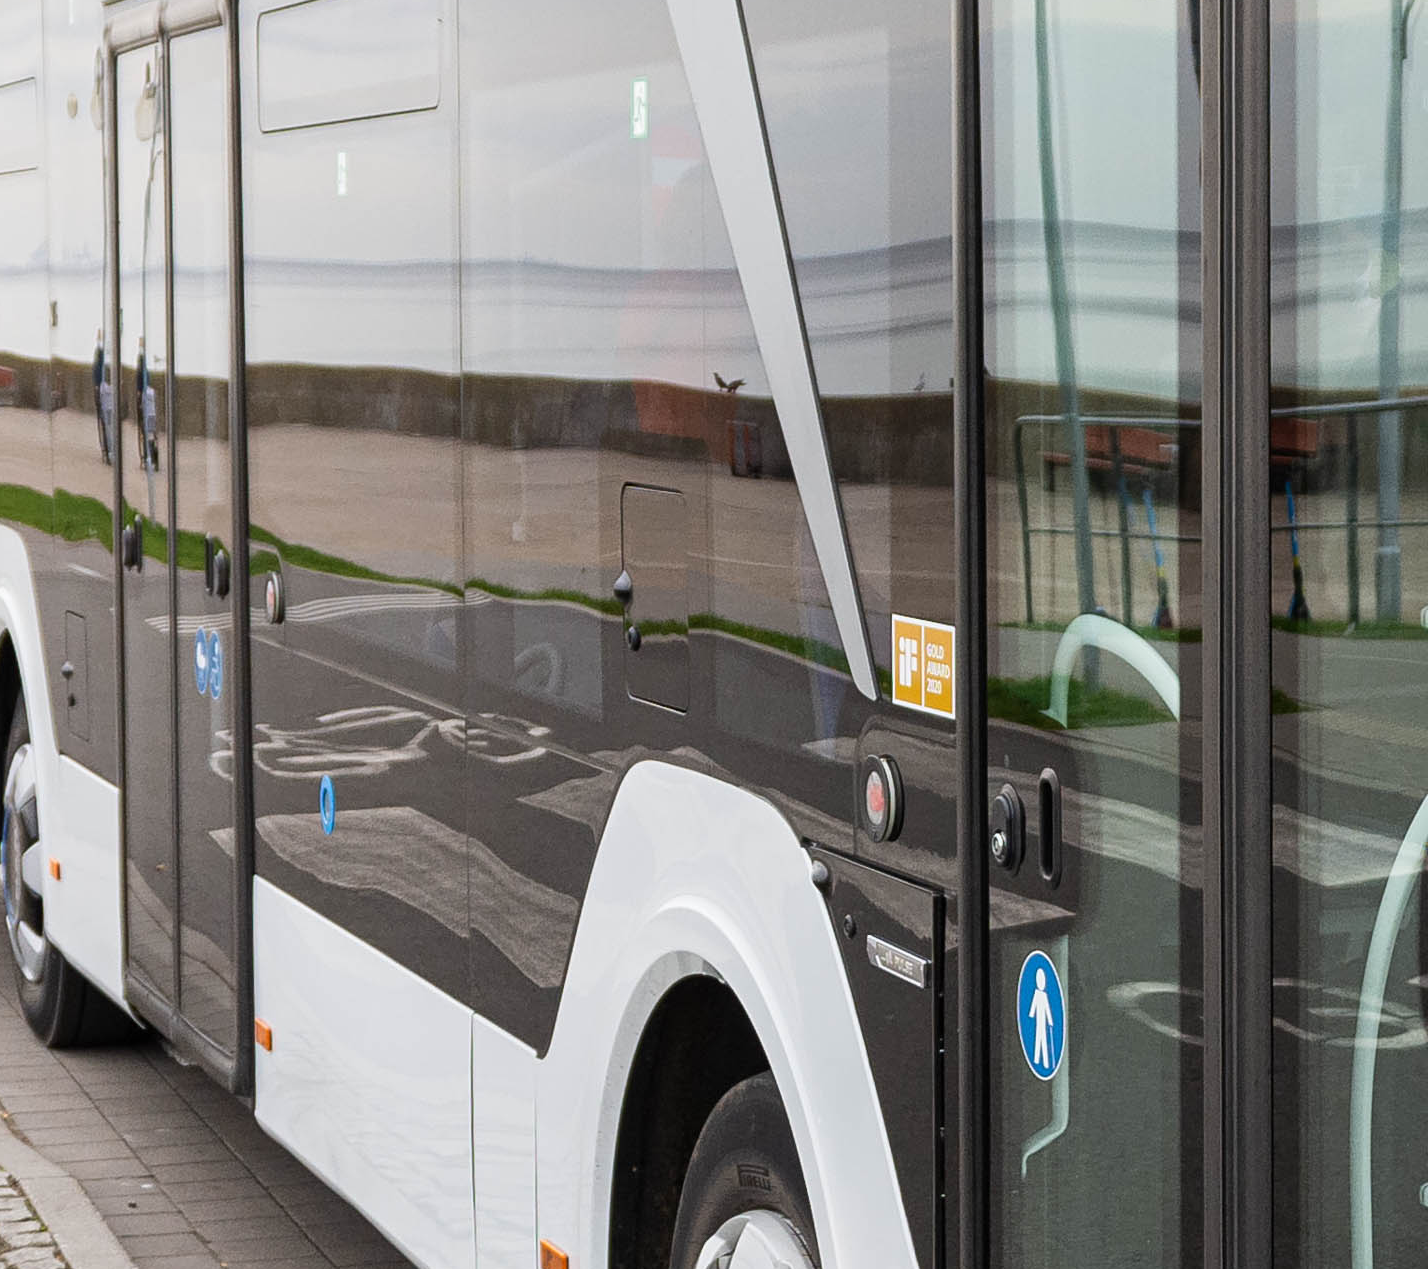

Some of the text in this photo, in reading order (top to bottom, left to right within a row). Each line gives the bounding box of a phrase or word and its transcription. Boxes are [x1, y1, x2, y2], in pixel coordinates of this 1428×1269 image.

[926, 642, 945, 660] GOLD
[926, 660, 951, 679] AWARD
[926, 678, 942, 695] 2020
